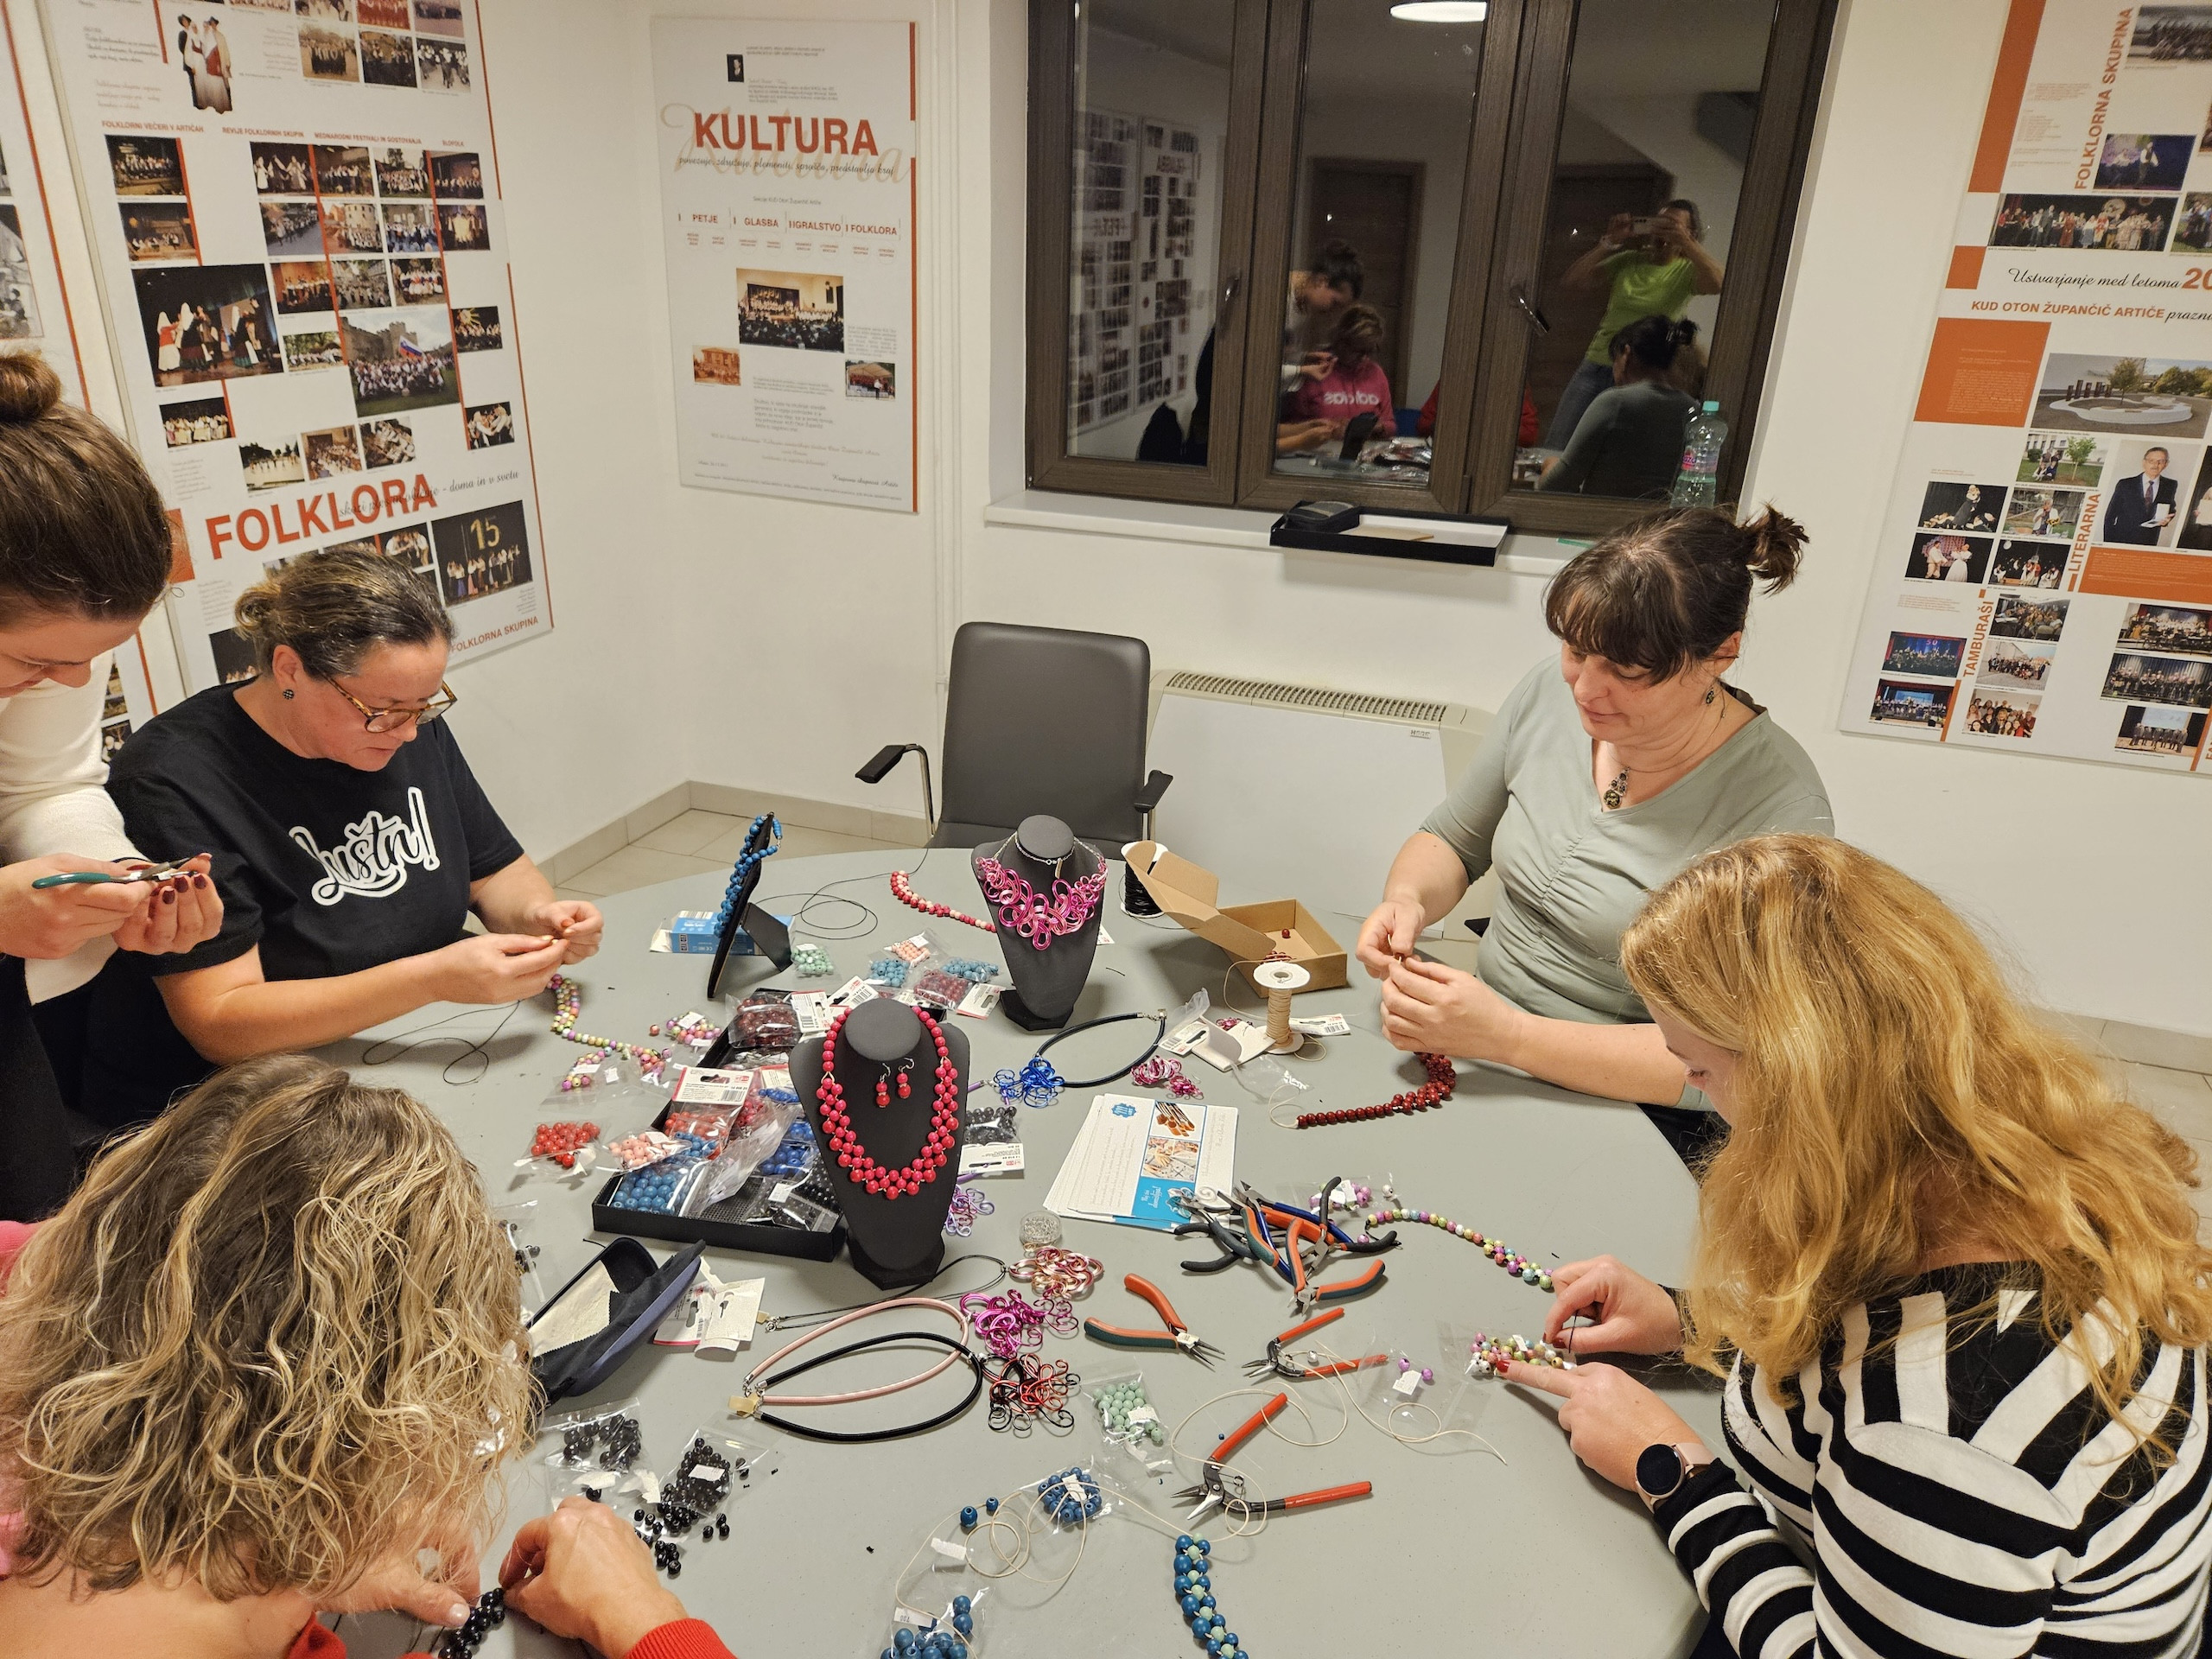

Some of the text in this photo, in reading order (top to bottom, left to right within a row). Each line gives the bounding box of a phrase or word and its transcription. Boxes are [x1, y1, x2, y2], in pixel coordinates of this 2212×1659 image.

[2075, 7, 2133, 189] FOLKLORNA SKUPINA
[101, 120, 143, 130] FOLKLORNI
[695, 112, 879, 156] KULTURA
[830, 162, 874, 174] predstavlja
[877, 162, 895, 176] kraj
[692, 214, 718, 223] PETJE
[744, 217, 779, 228] GLASBA
[792, 220, 842, 232] IGRALSTVO
[851, 225, 898, 235] FOLKLORA
[2008, 268, 2094, 289] Ustvarjanje
[2098, 274, 2129, 287] med
[2131, 274, 2182, 289] letoma
[1971, 301, 1999, 311] KUD
[2002, 302, 2040, 313] OTON
[2043, 301, 2111, 316] ŽUPANČIČ
[2113, 306, 2164, 319] ARTIČE
[449, 480, 474, 493] doma
[476, 475, 486, 486] in
[488, 476, 494, 485] v
[497, 470, 518, 482] svetu
[205, 474, 438, 560] FOLKLORA
[470, 518, 500, 550] 15
[2068, 493, 2101, 571] LITERARNA
[450, 616, 538, 653] FOLKLORNA SKUPINA
[1963, 601, 1994, 677] TAMBURAŠI
